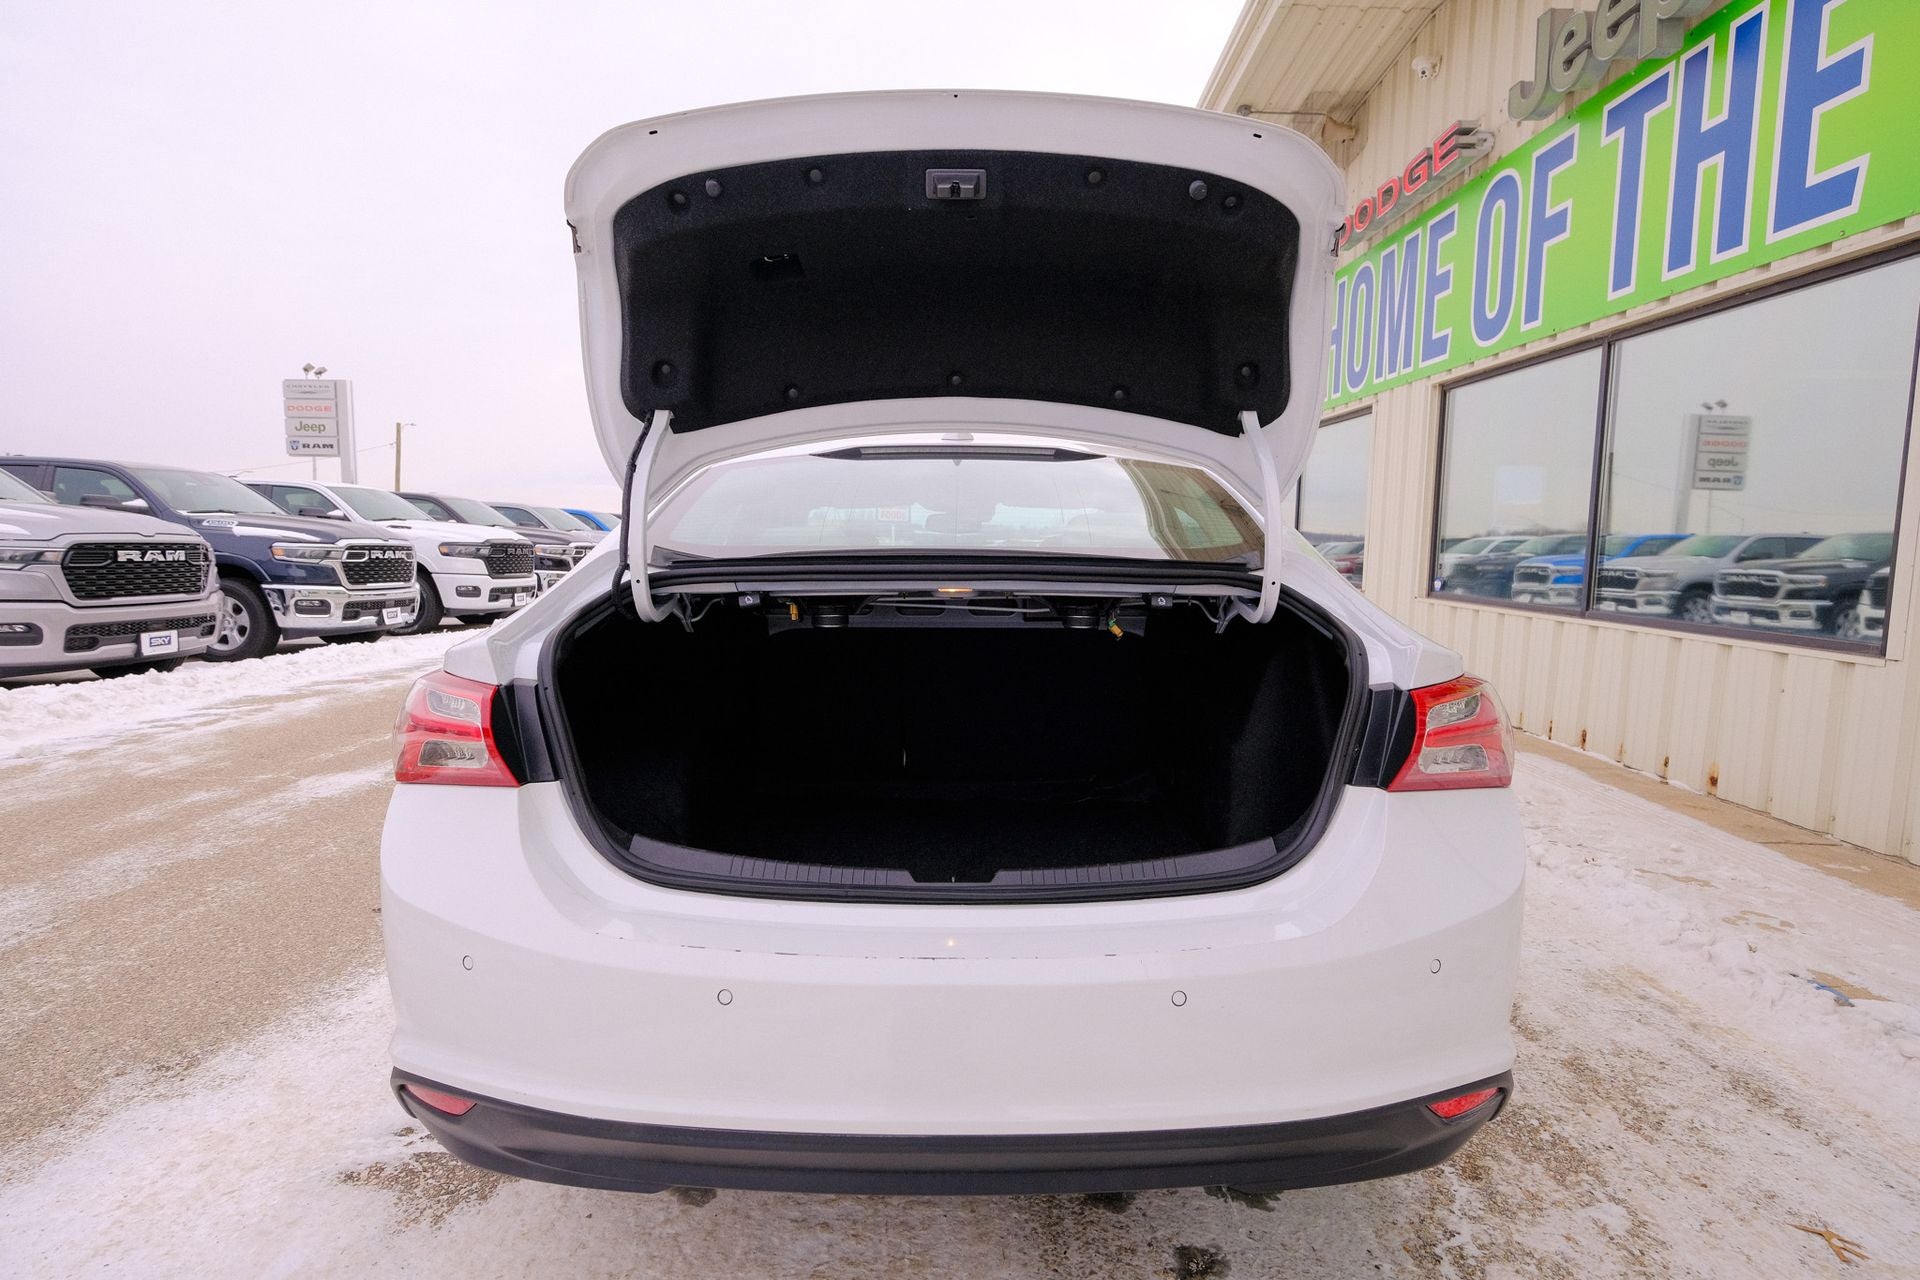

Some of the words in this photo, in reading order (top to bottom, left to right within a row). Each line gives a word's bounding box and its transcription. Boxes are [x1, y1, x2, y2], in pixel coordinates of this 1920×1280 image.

[1471, 122, 1581, 348] OF
[1600, 0, 1875, 302] THE
[294, 420, 326, 433] Jeep
[117, 550, 186, 562] RAM
[370, 550, 406, 559] RAM
[507, 547, 529, 555] RAM
[150, 636, 171, 647] SKY
